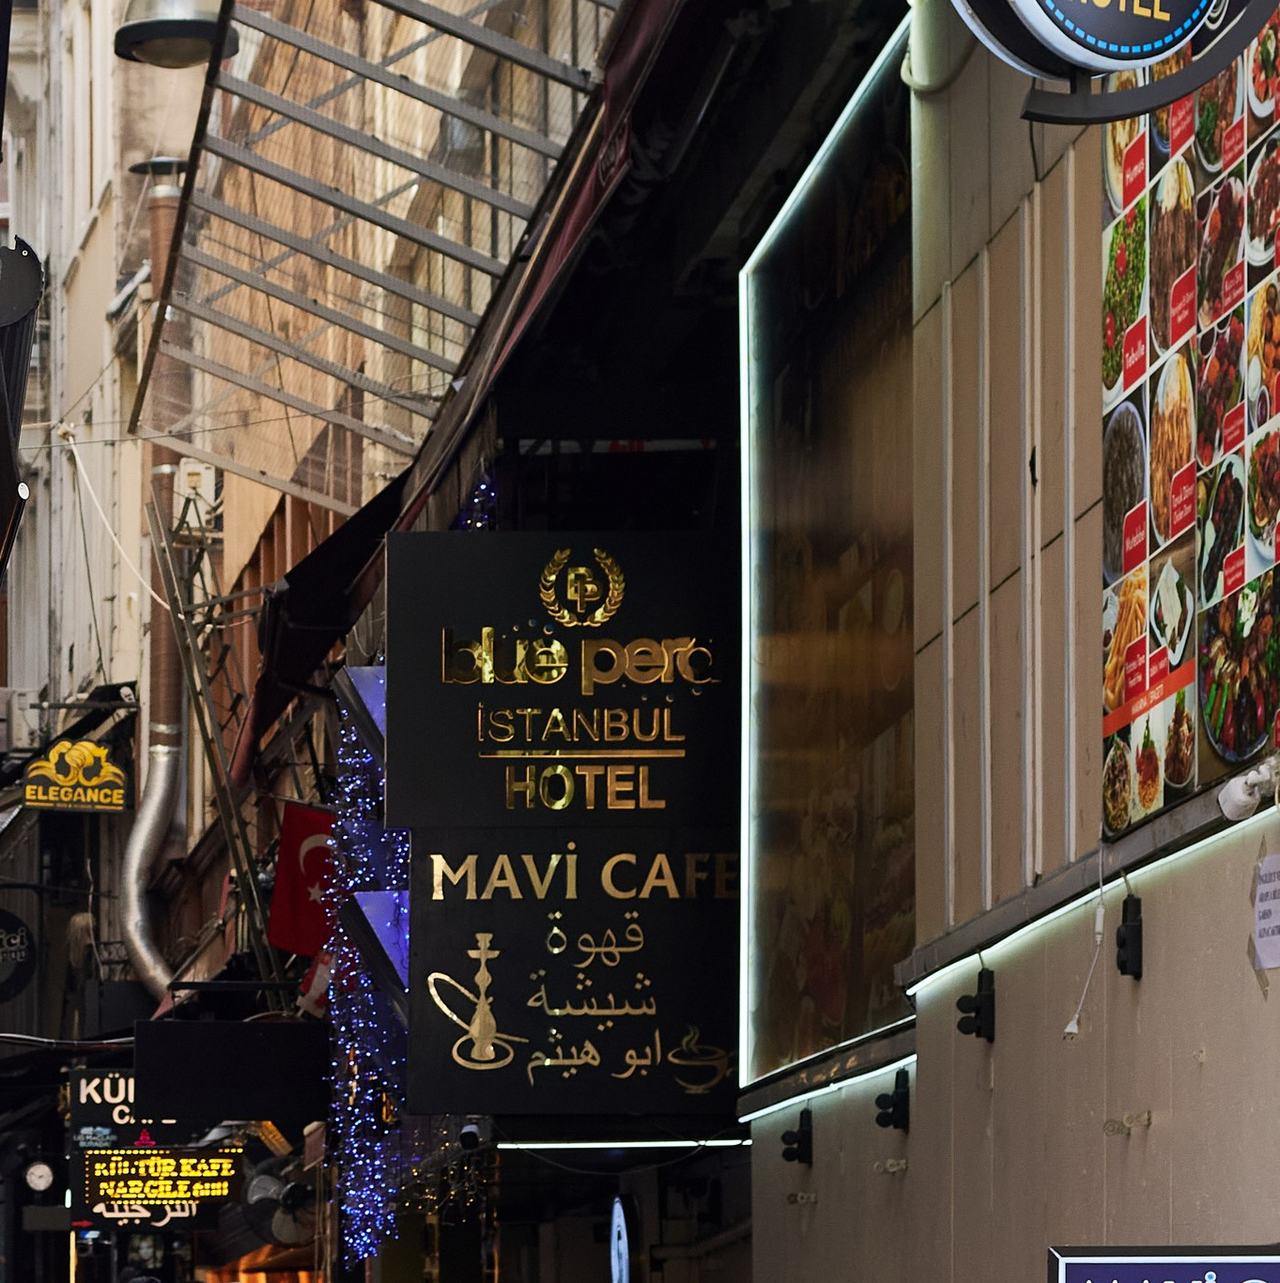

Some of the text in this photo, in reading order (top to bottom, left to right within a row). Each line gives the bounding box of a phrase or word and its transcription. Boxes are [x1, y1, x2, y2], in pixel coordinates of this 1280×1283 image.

[441, 626, 720, 696] blue pera
[477, 702, 686, 742] İSTANBUL
[25, 785, 125, 805] ELEGANCE
[505, 764, 666, 810] HOTEL
[429, 841, 739, 901] MAVİ CAFE
[545, 911, 645, 968] قهوة
[527, 969, 657, 1030] شيشة
